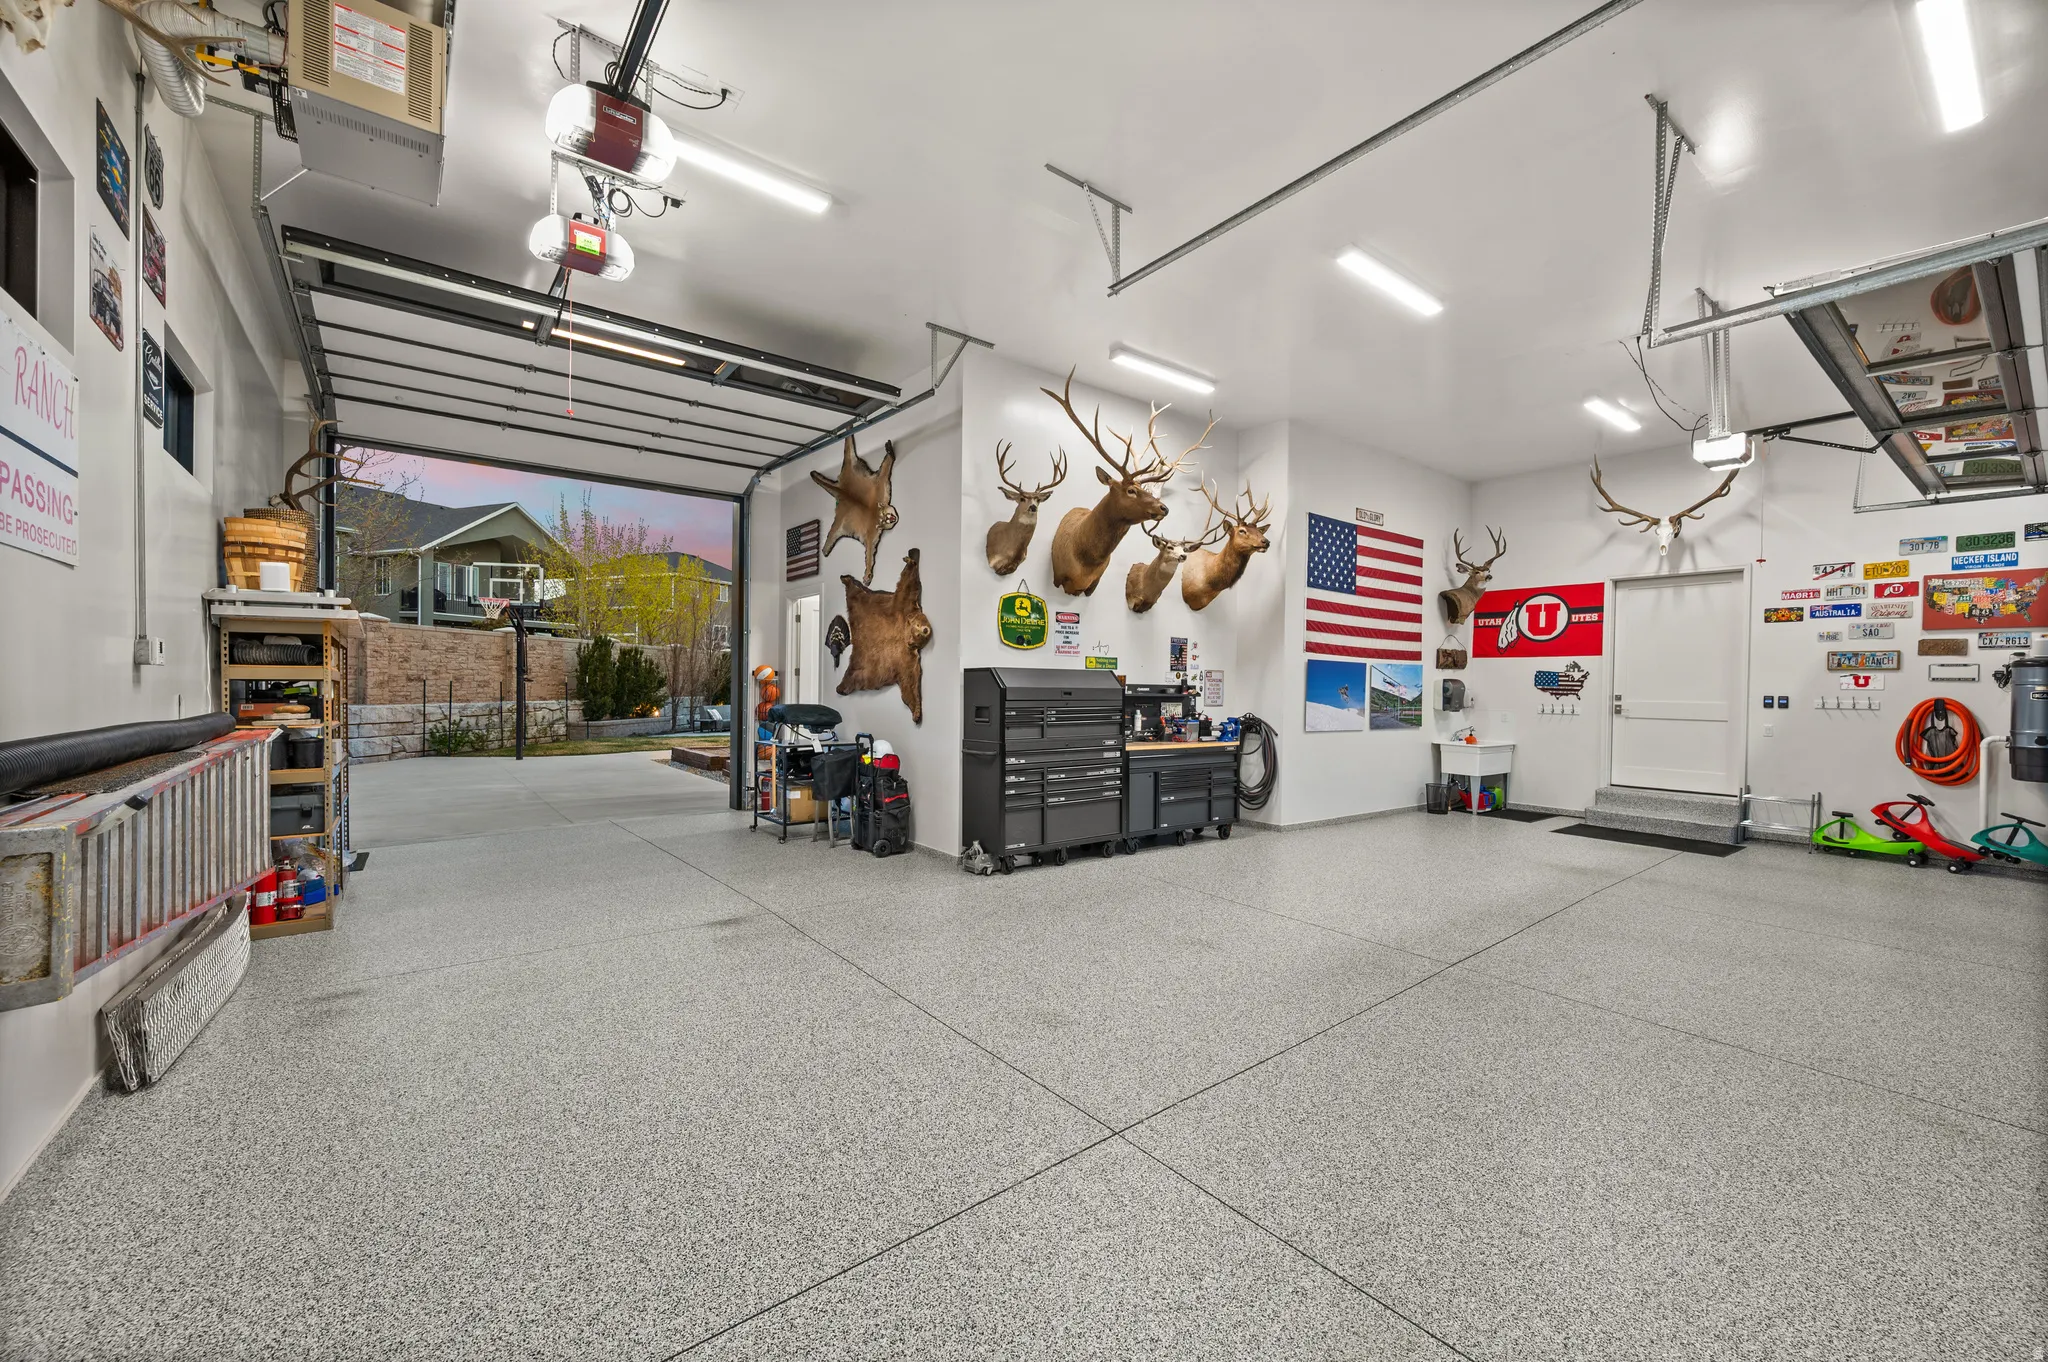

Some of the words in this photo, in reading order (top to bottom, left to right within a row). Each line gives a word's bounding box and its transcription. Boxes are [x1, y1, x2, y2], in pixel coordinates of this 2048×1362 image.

[150, 157, 160, 202] 66
[14, 346, 74, 439] RANCH
[144, 394, 163, 420] SERVICE
[16, 521, 77, 556] PROSECUTED
[1953, 554, 1984, 565] NECKER
[1987, 552, 2017, 562] ISLAND
[1890, 564, 1907, 573] 203
[1826, 588, 1842, 597] HHT
[1851, 586, 1866, 595] 101
[1021, 617, 1045, 625] DEERE
[1526, 603, 1561, 636] U
[1572, 614, 1598, 622] UTES
[1865, 657, 1894, 666] RANCH
[1853, 675, 1871, 687] U
